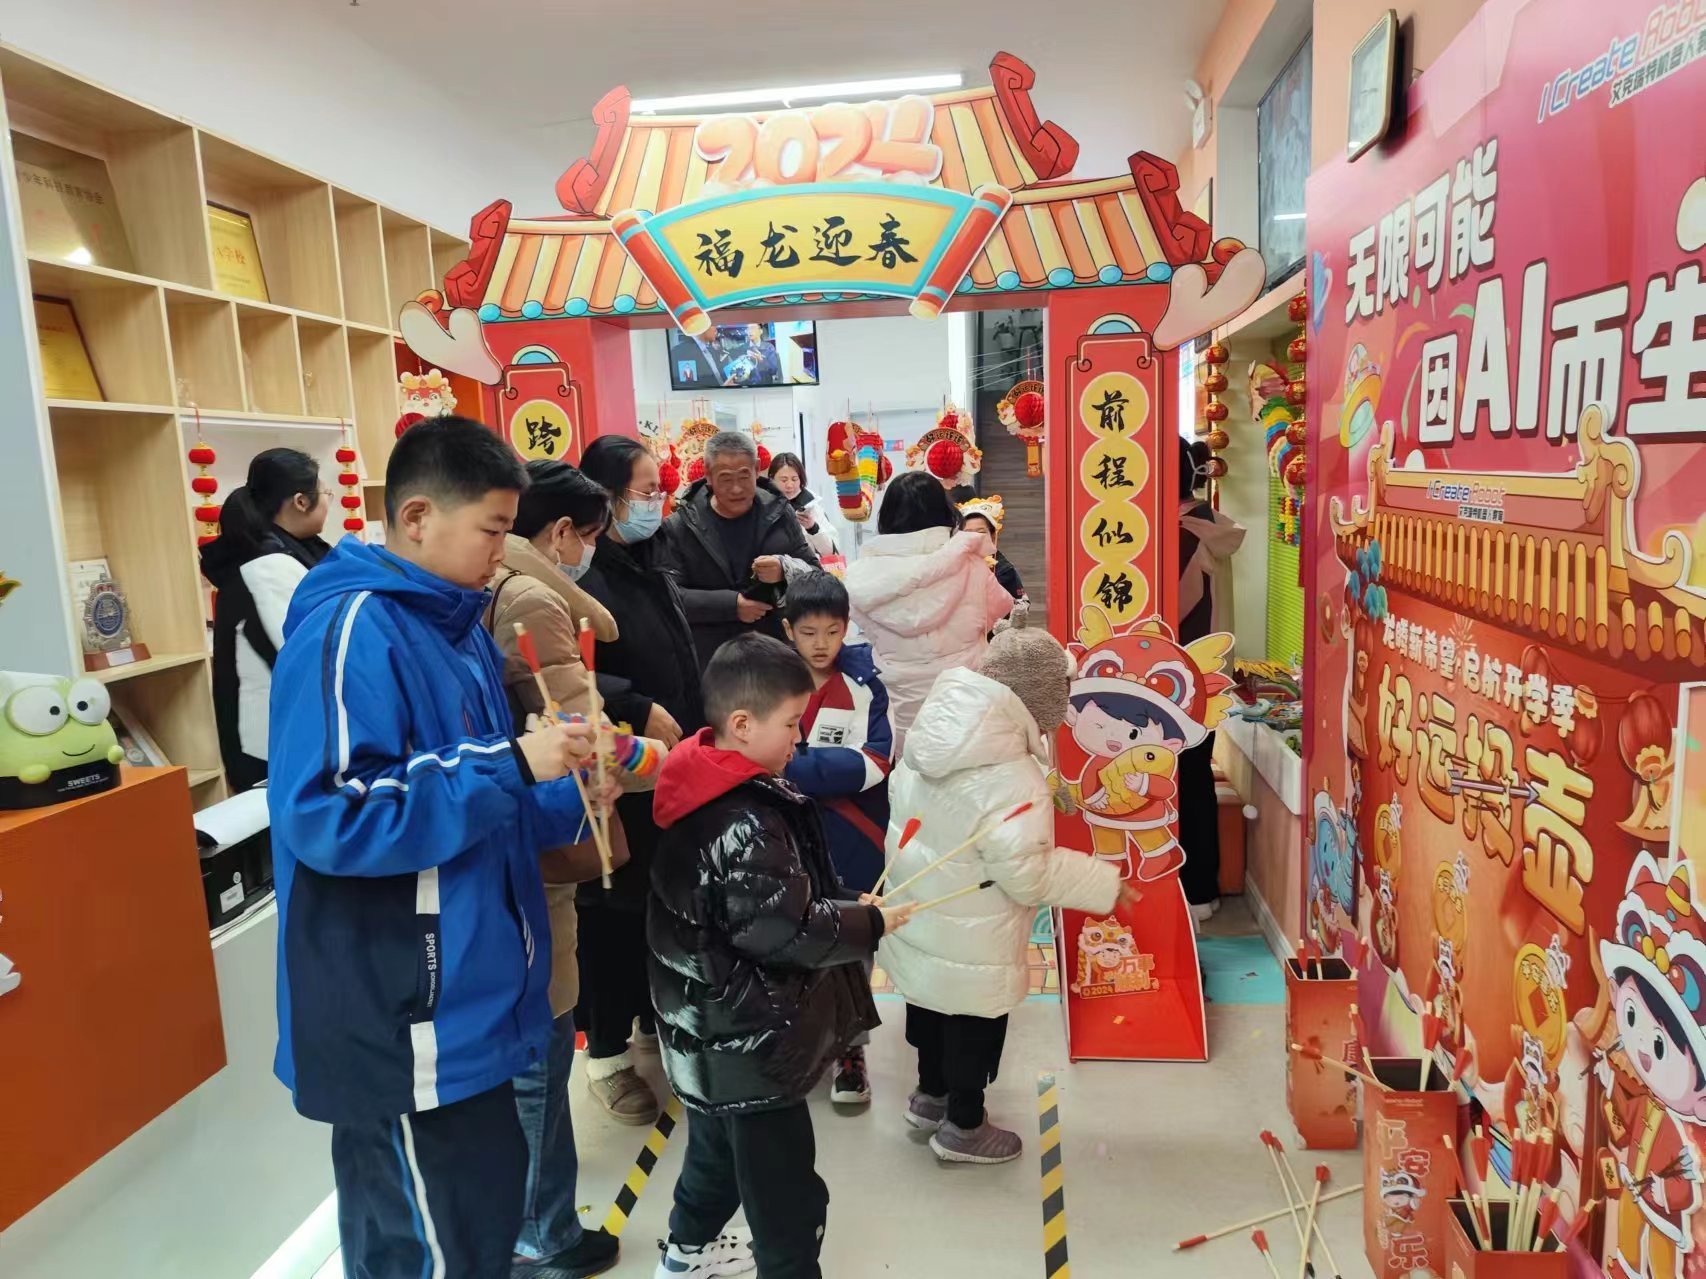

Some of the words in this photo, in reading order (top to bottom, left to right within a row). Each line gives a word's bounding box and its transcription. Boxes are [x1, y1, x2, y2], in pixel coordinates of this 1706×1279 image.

[697, 96, 942, 185] 2024
[694, 213, 920, 278] 福龙迎春
[1345, 138, 1498, 324] 无限可能
[525, 415, 562, 456] 跨
[1091, 389, 1135, 613] 前程似锦
[67, 773, 101, 787] SWEETS
[424, 932, 437, 971] SPORTS
